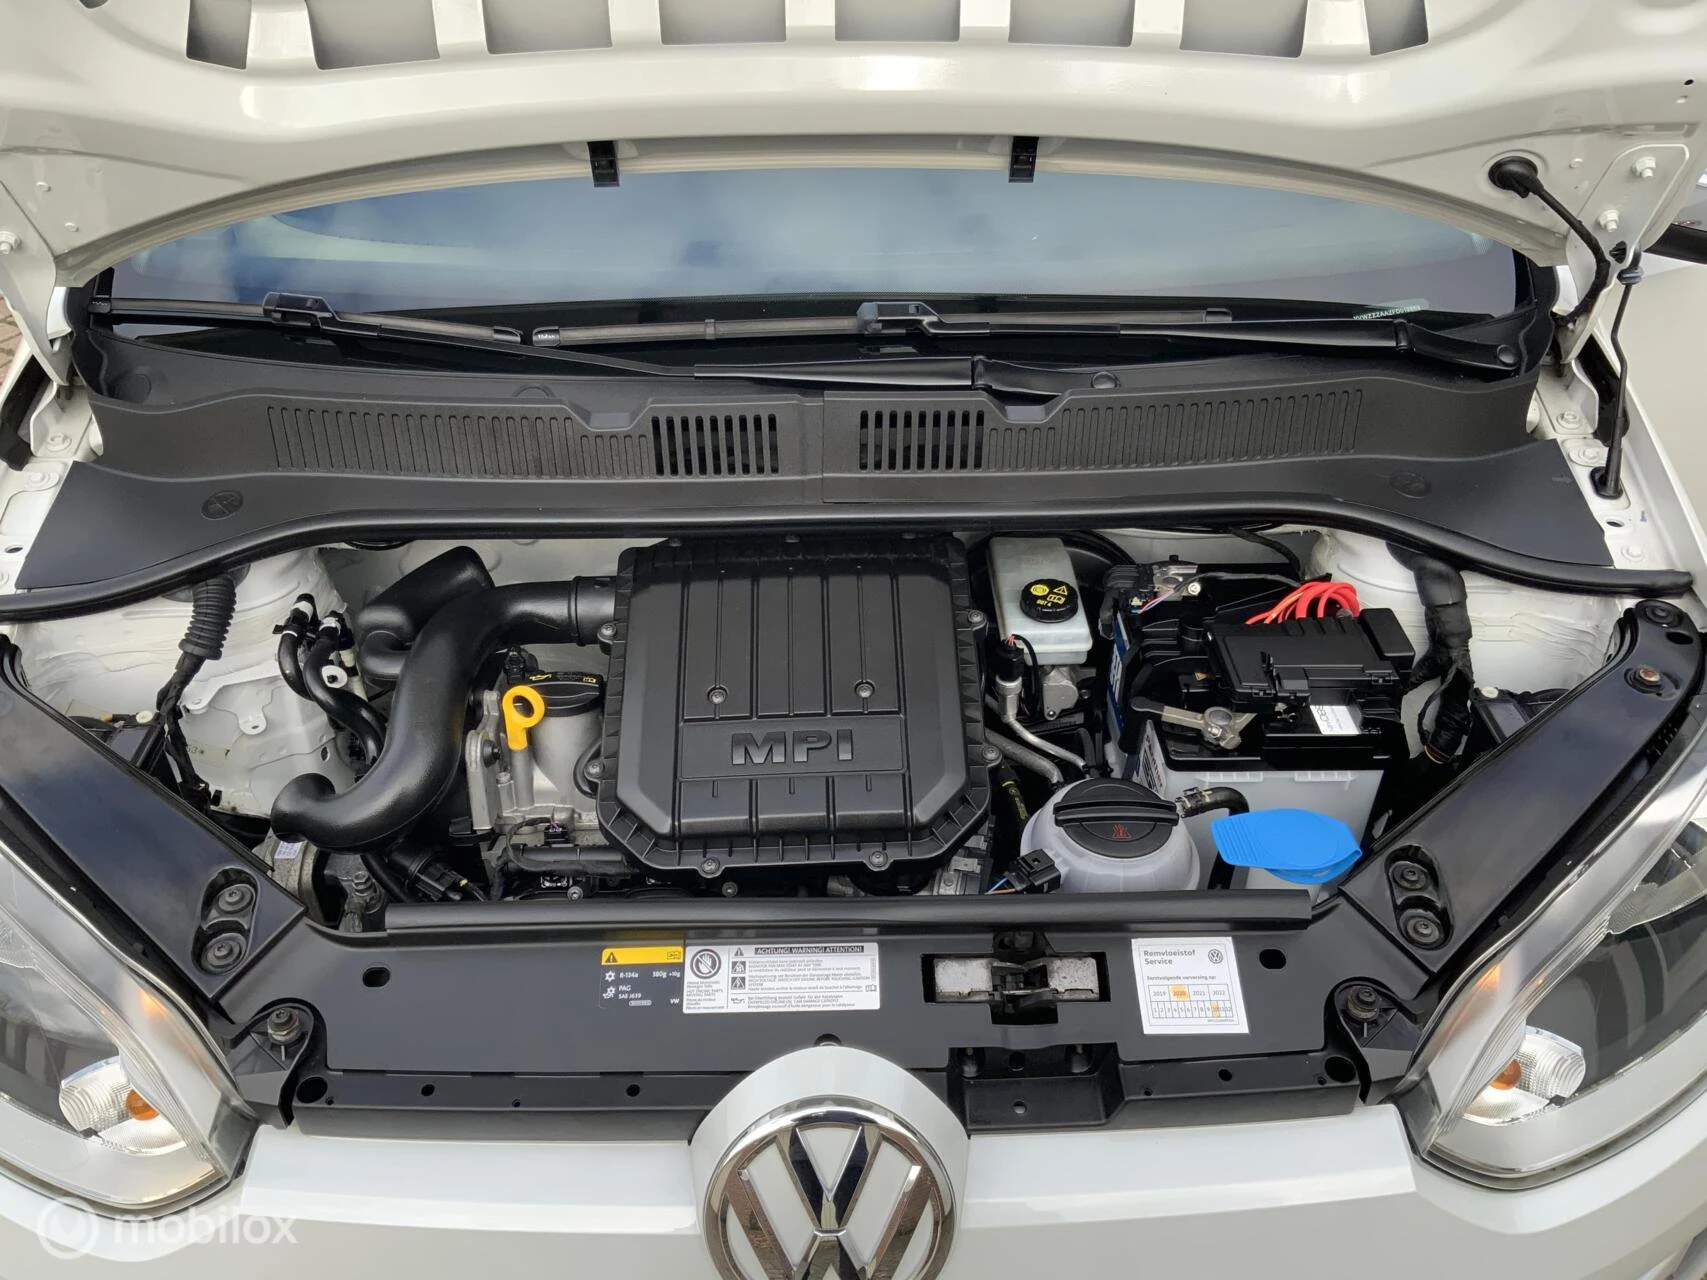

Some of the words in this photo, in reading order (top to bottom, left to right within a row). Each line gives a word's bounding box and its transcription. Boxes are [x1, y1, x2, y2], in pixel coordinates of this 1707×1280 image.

[732, 728, 853, 765] MPI
[825, 945, 862, 953] ATTENTION!
[1143, 949, 1196, 957] Remvloeistof
